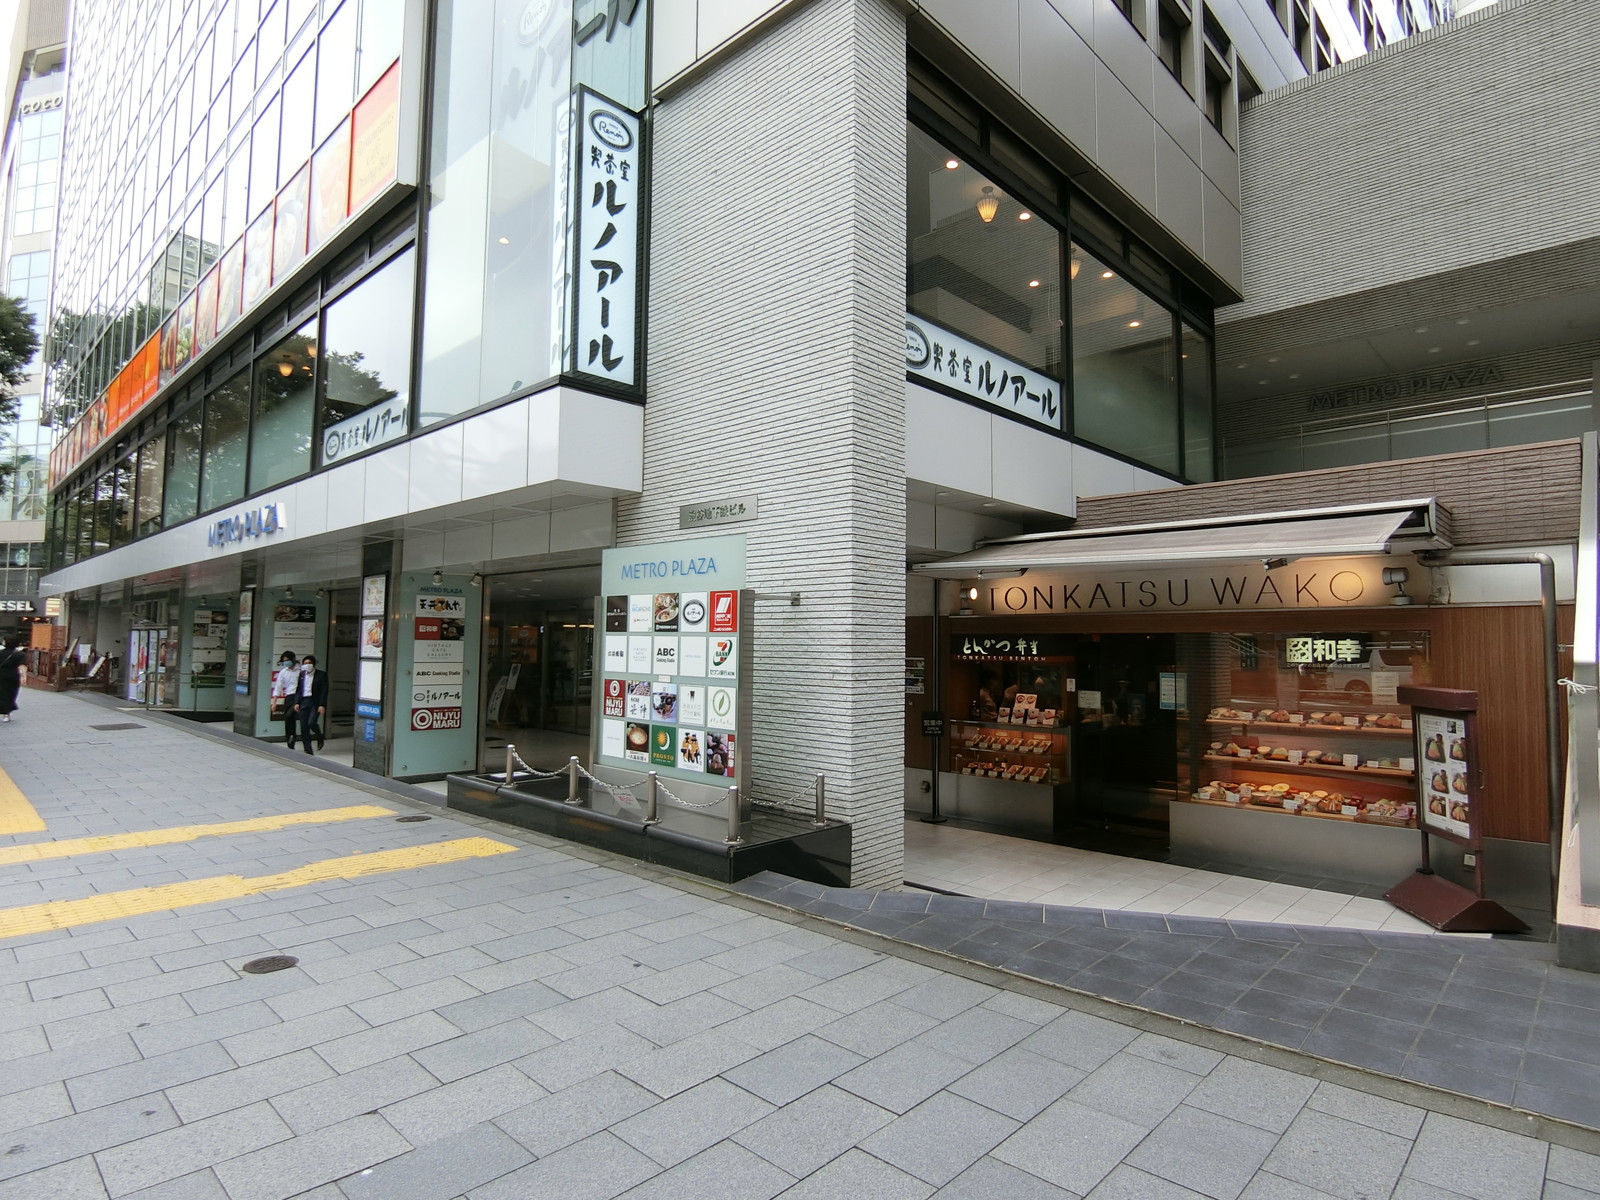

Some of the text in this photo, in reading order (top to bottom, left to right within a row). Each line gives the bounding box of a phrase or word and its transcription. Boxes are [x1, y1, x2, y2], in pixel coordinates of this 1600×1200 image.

[588, 179, 627, 372] ルノアール
[1309, 365, 1503, 412] METRO PLAZA
[621, 557, 717, 579] METRO PLAZA
[989, 570, 1364, 611] TONKATSU WAKO
[656, 647, 675, 657] ABC
[431, 692, 461, 701] ルノアール
[433, 711, 460, 721] NIJYU
[605, 706, 623, 717] MARU
[432, 719, 460, 729] MARU
